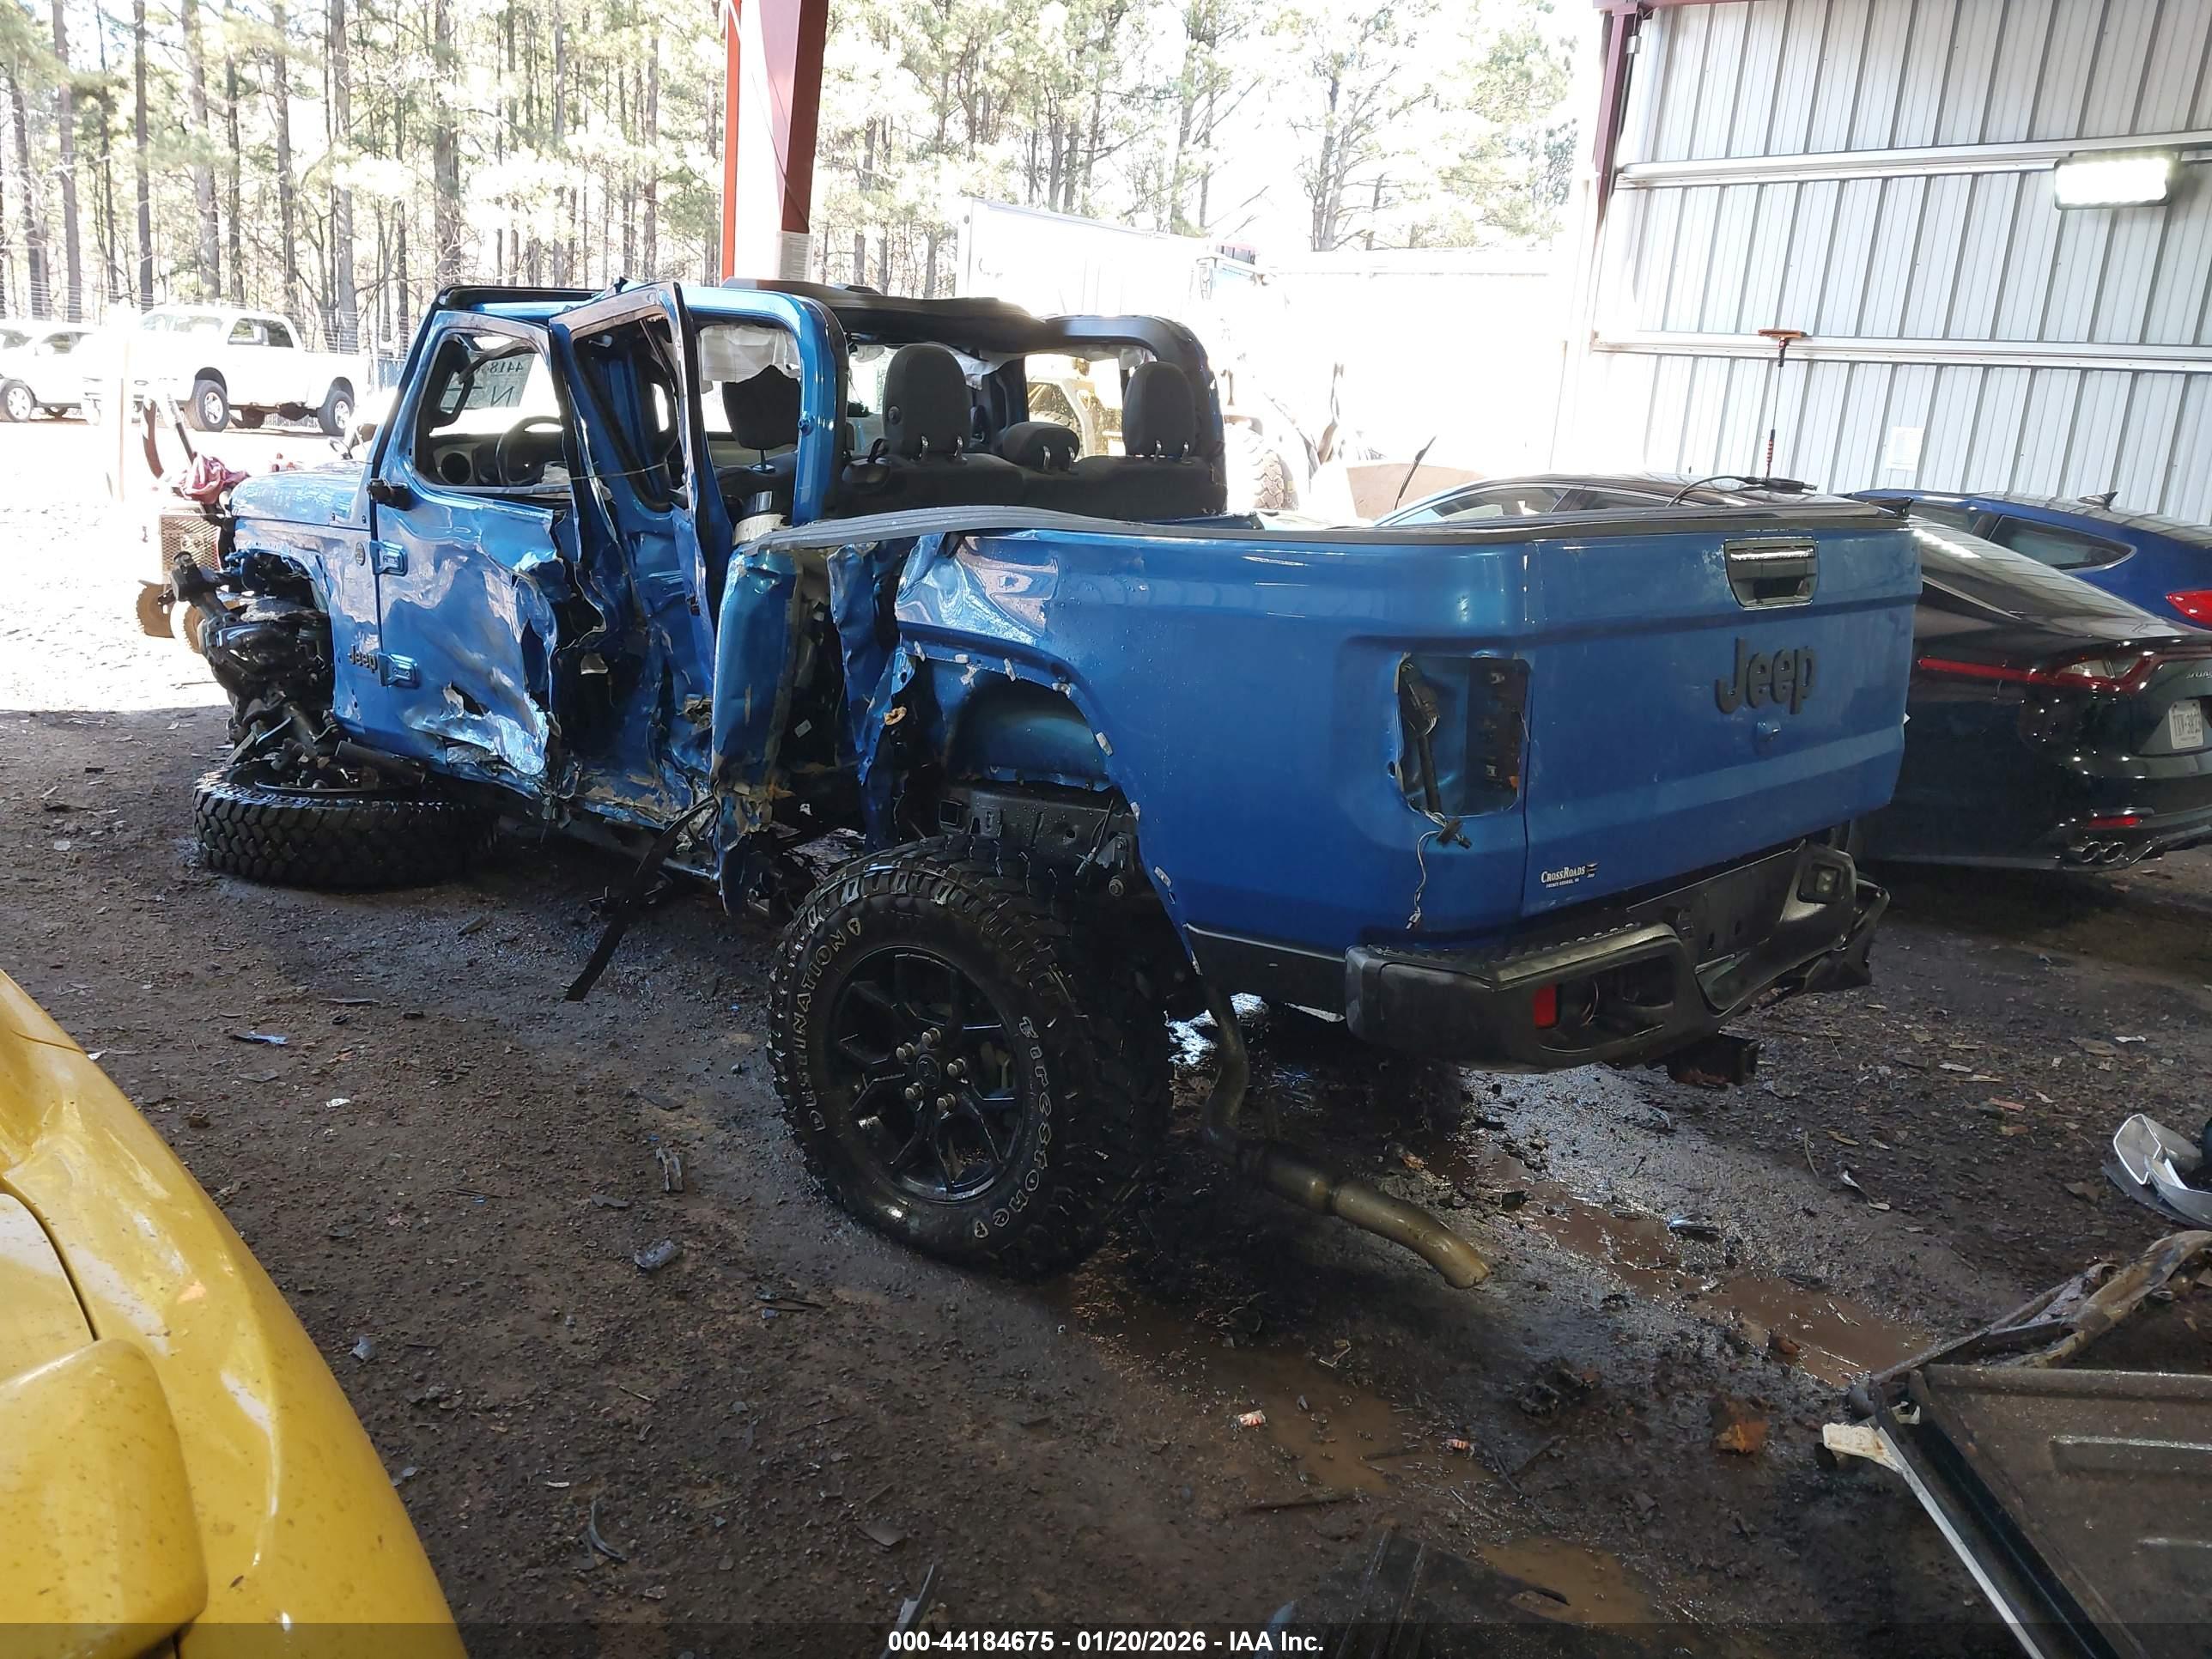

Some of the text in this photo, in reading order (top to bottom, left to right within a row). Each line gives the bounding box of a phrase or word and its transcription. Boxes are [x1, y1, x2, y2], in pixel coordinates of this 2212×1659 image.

[347, 644, 378, 673] Jeep
[1714, 636, 1817, 715] Jeep
[793, 928, 847, 1132] DESTINATION
[993, 1015, 1053, 1228] Firestone
